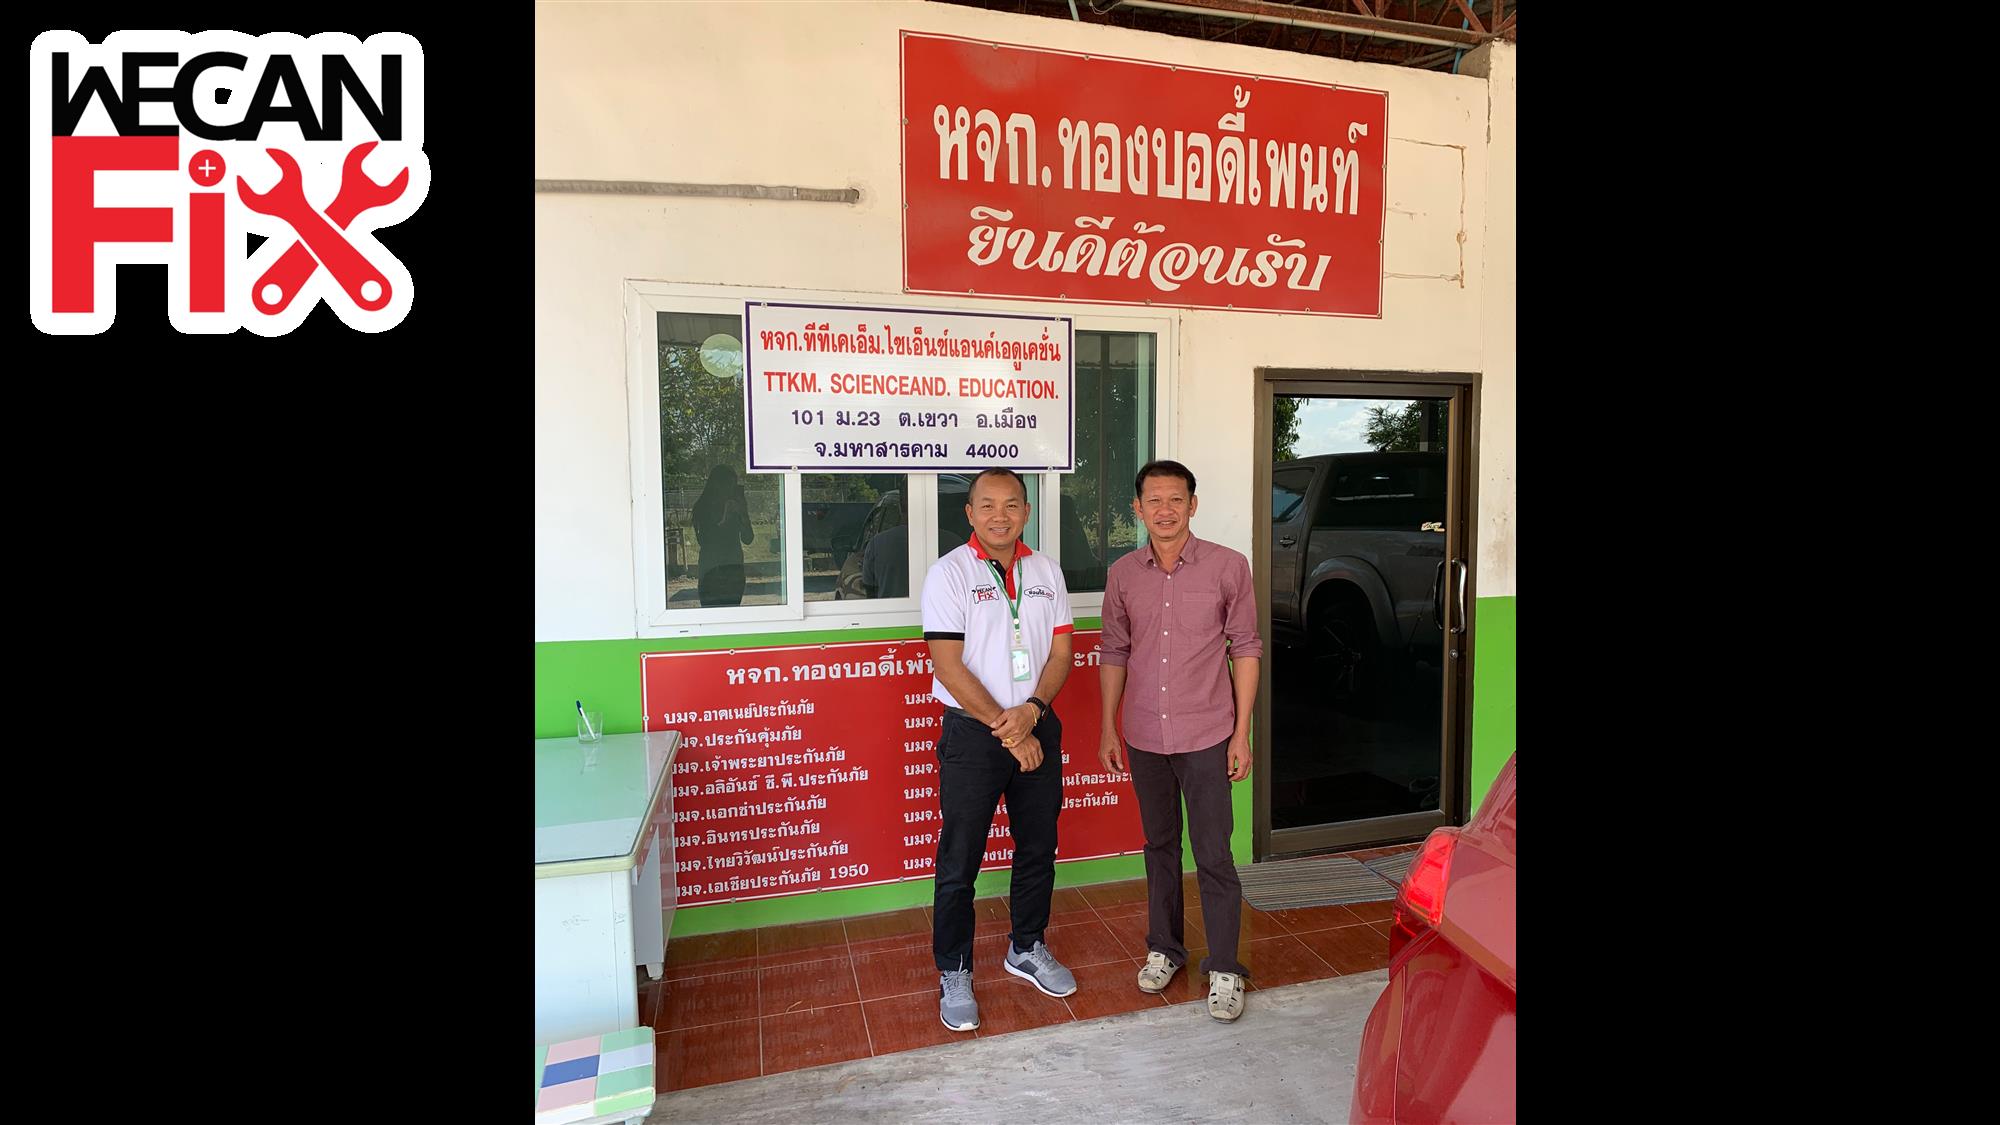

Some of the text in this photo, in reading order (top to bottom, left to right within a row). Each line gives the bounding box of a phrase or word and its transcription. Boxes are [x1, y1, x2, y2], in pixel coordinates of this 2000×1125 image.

[933, 85, 1368, 216] หจก.ทองบอดี้เพนท์
[967, 205, 1332, 291] ยินดีต้อนรับ
[763, 371, 1059, 400] TTKM. SCIENCEAND. EDUCATION.
[792, 407, 1037, 429] 101 ม.23 ต.เขวา อ.เมือง
[814, 441, 1019, 458] จ.มหาสารคาม 44000
[664, 698, 815, 725] บมจ.อาคเนย์ประกันภัย
[680, 725, 802, 749] มจ.ประกันคุ้มภัย
[904, 786, 940, 799] บมจ.
[829, 864, 870, 881] 1950
